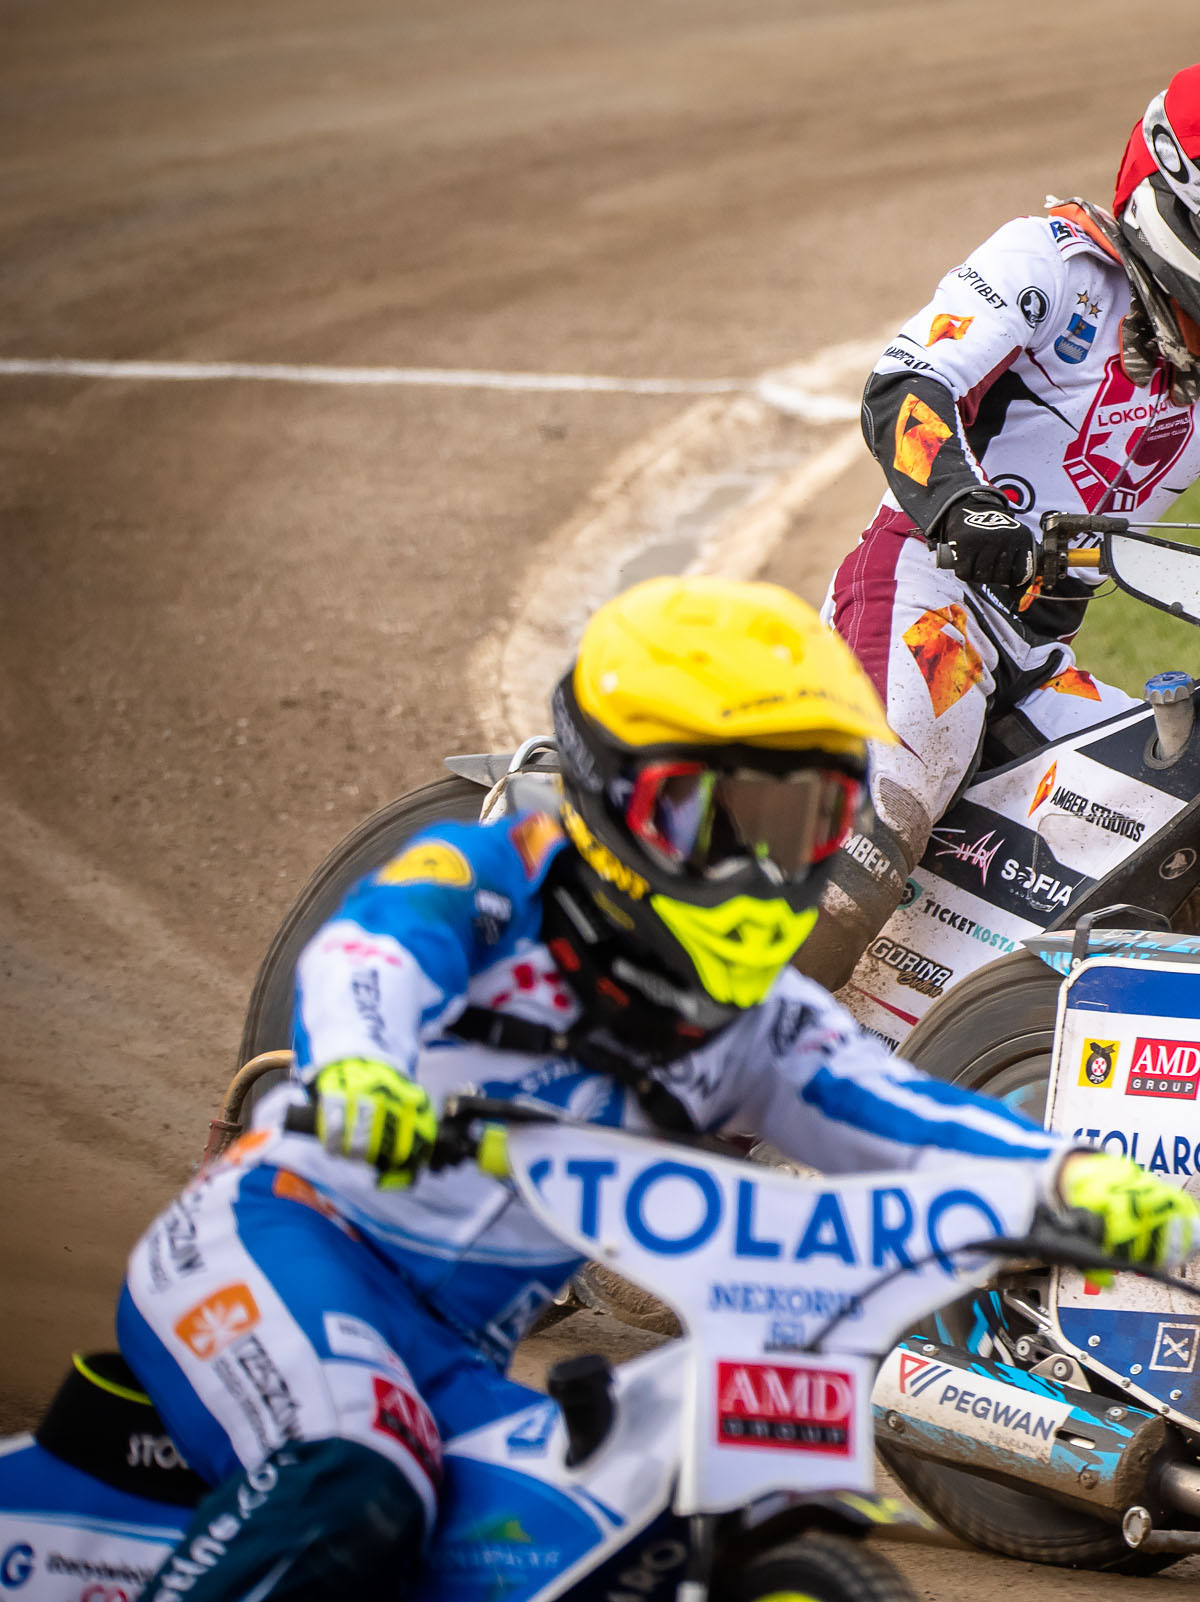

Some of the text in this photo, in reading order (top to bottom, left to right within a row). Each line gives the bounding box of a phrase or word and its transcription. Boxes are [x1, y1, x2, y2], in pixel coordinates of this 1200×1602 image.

[958, 265, 1007, 310] OPTIBET
[1050, 786, 1088, 817] AMBER
[1001, 859, 1073, 907] SOFIA
[870, 937, 952, 988] GORINA
[1132, 1078, 1194, 1094] GROUP
[526, 1158, 1006, 1280] STOLARO
[717, 1367, 853, 1421] AMD
[939, 1384, 1056, 1442] PEGWAN
